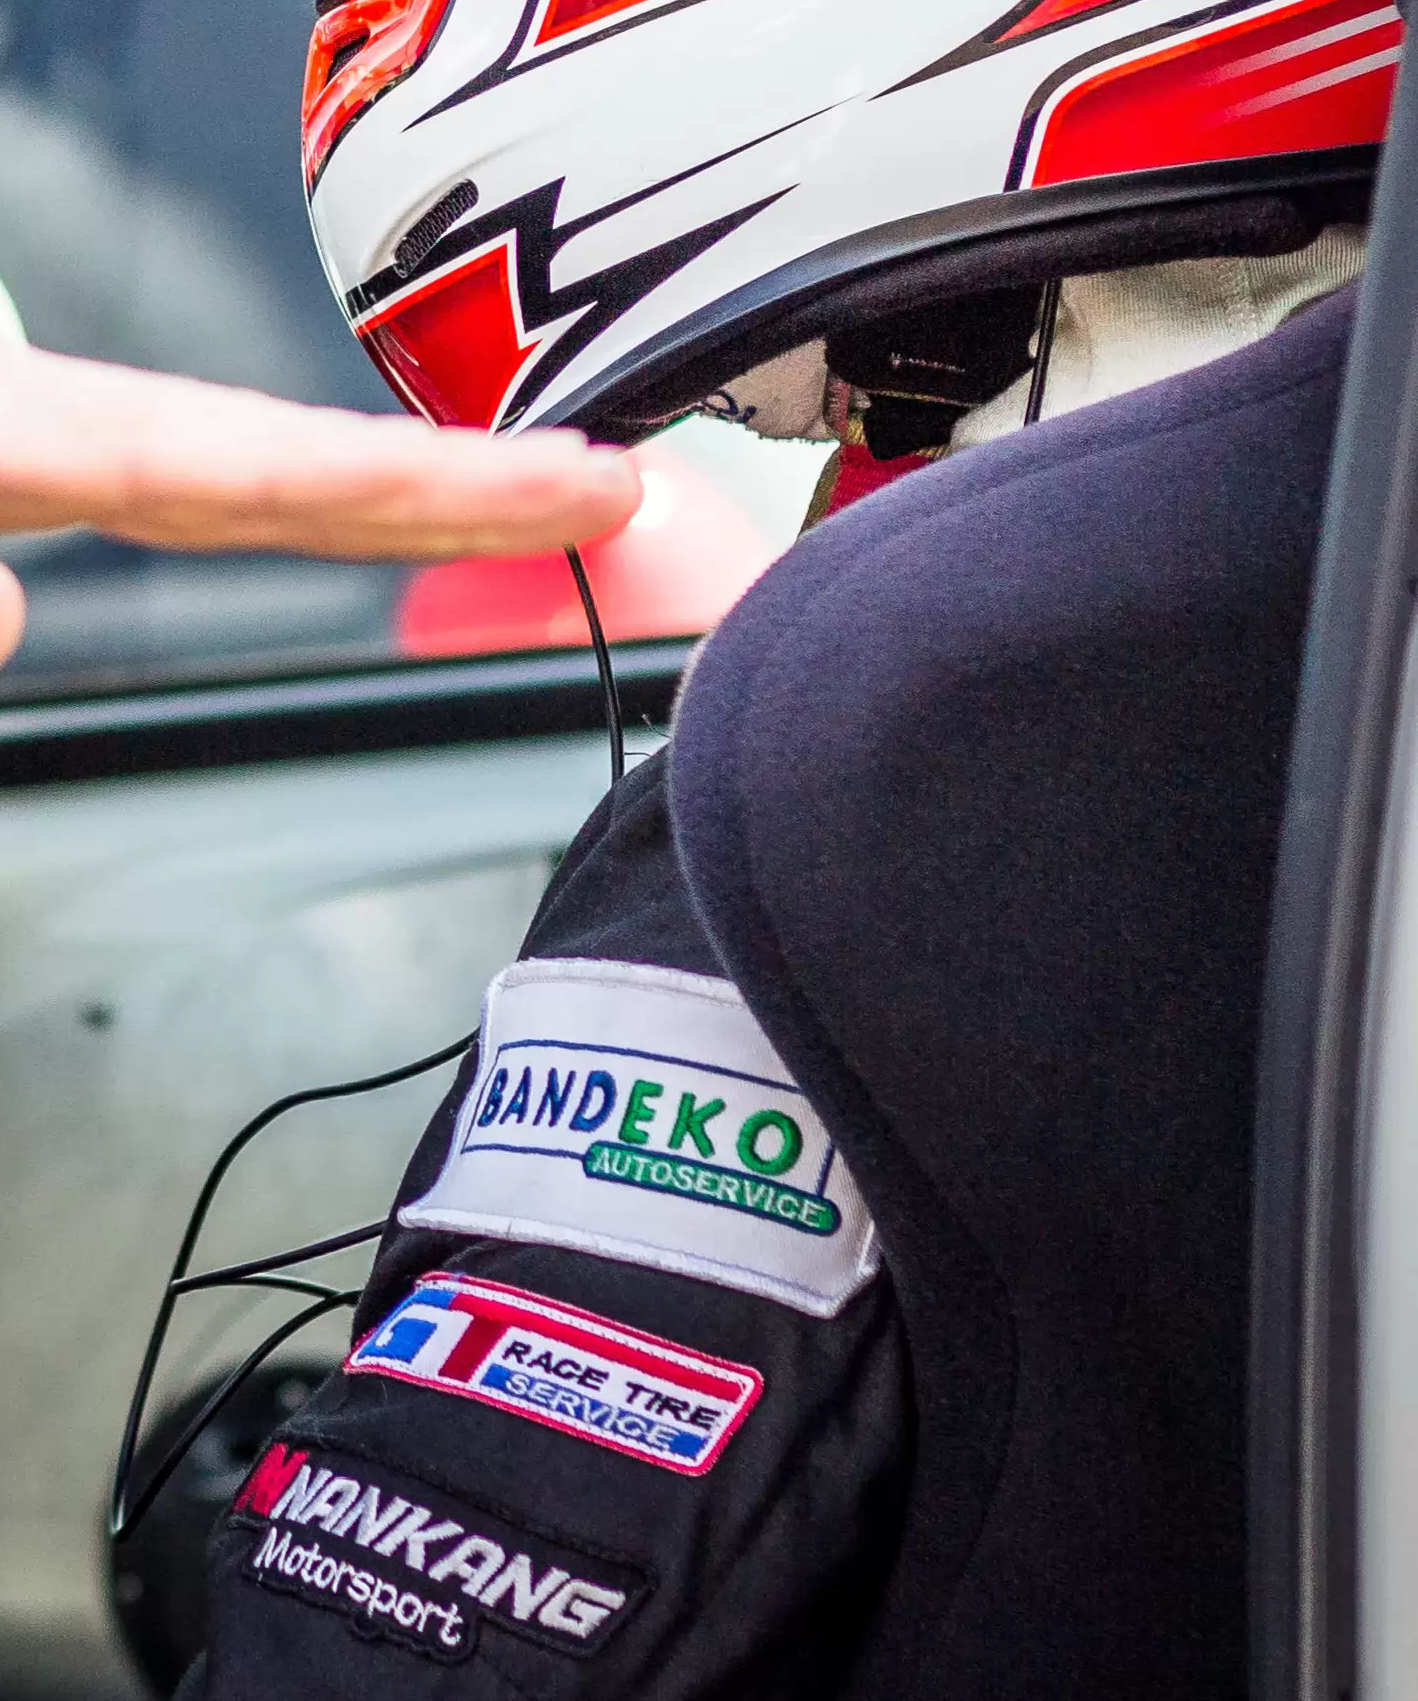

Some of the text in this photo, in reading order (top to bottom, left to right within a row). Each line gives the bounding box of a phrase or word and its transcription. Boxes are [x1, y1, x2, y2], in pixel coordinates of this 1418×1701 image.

[477, 1065, 804, 1176] BANDEKO
[592, 1148, 827, 1228] AUTOSERVICE
[502, 1340, 722, 1430] RACE TIRE
[504, 1371, 683, 1450] SERVICE
[253, 1526, 464, 1647] Motorsport
[269, 1463, 627, 1639] NANKANG
